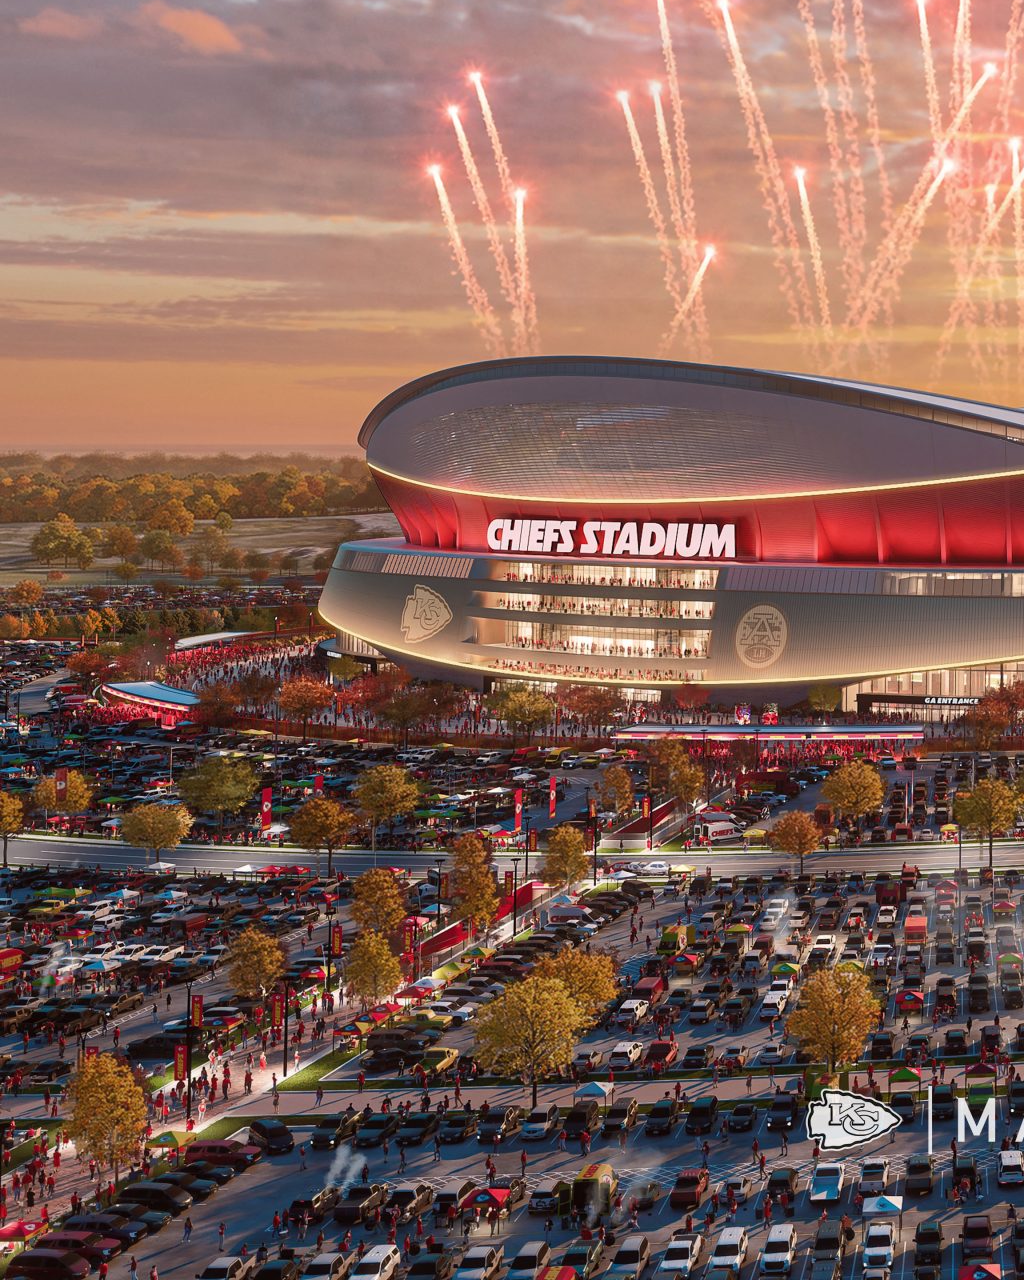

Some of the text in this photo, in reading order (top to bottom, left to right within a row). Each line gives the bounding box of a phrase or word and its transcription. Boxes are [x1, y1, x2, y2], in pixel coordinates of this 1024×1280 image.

[487, 518, 736, 558] CHIEFS STADIUM
[413, 598, 440, 630] KC
[937, 697, 979, 705] ENTRANCE
[711, 828, 734, 838] CHIEFS
